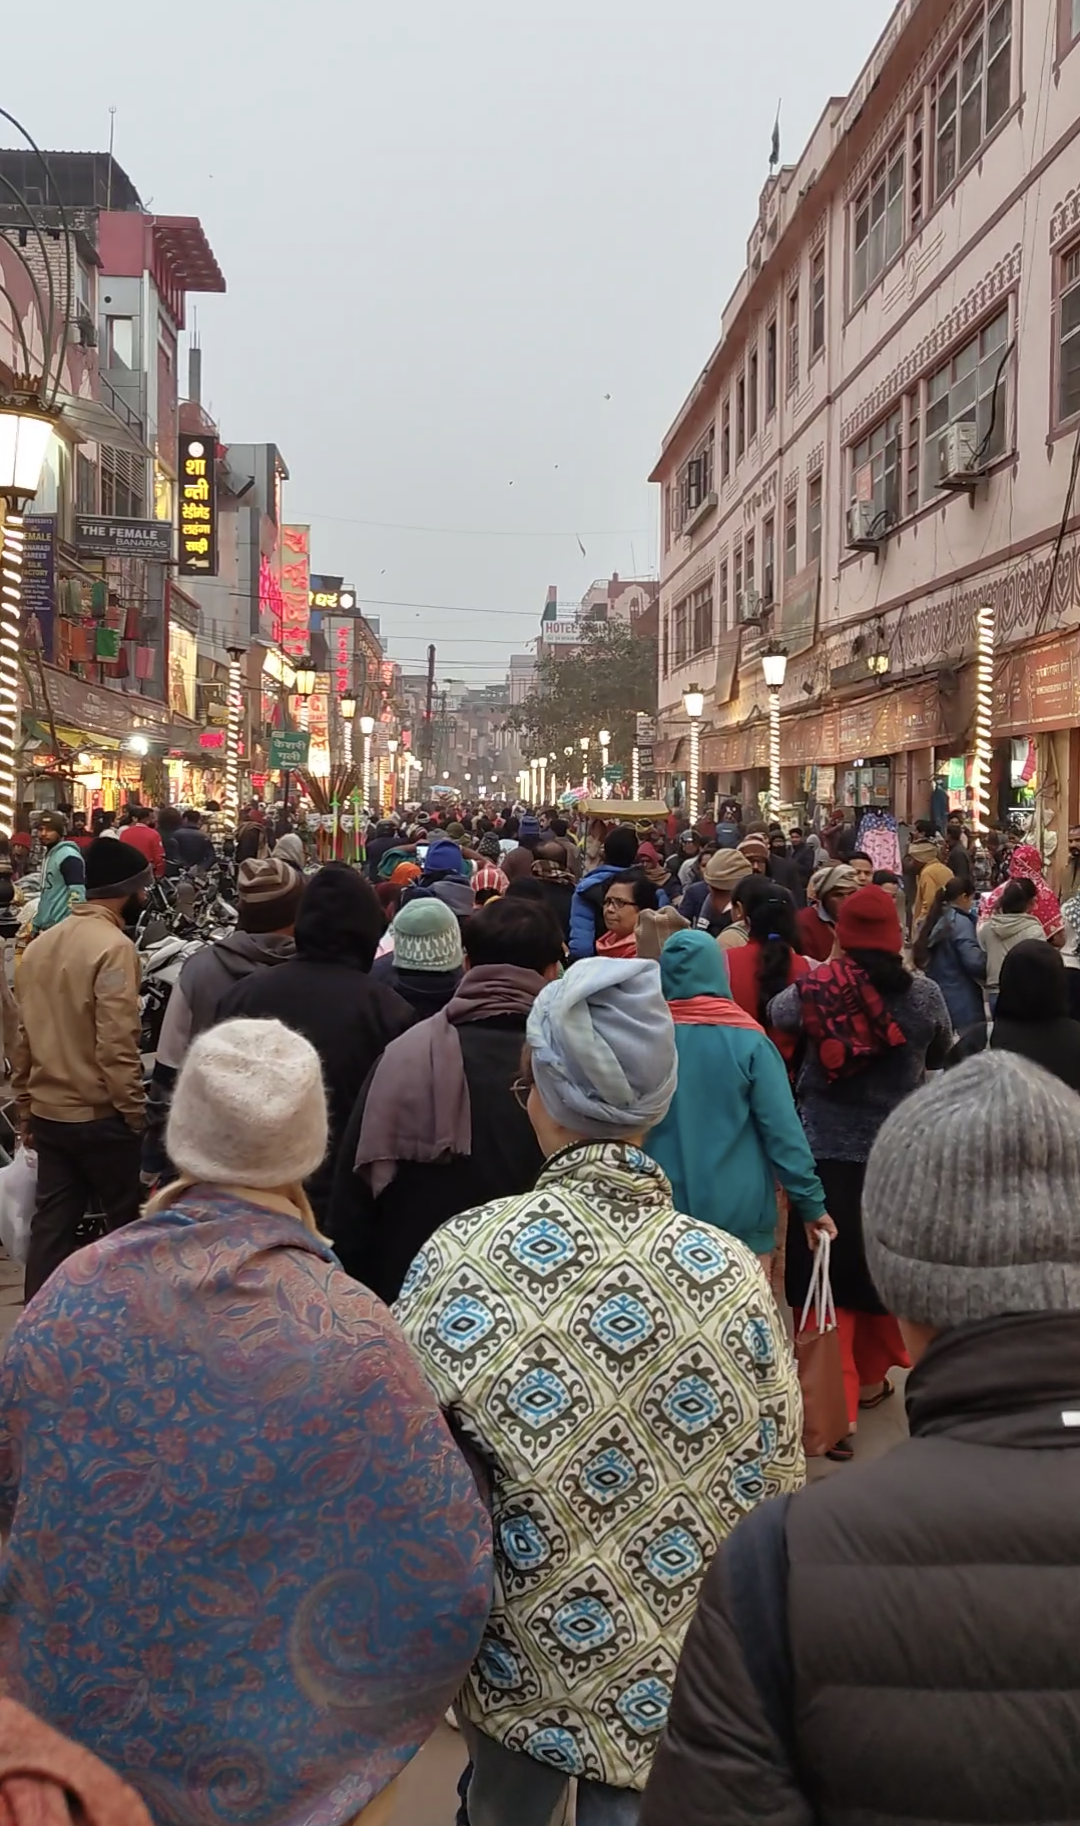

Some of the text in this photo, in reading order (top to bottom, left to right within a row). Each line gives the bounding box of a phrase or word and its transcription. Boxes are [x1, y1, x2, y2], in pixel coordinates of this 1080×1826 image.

[23, 532, 52, 541] EMALE
[81, 525, 158, 539] THE FEMALE
[115, 538, 167, 548] BANARAS
[545, 622, 577, 633] HOTEL
[277, 751, 301, 761] गली
